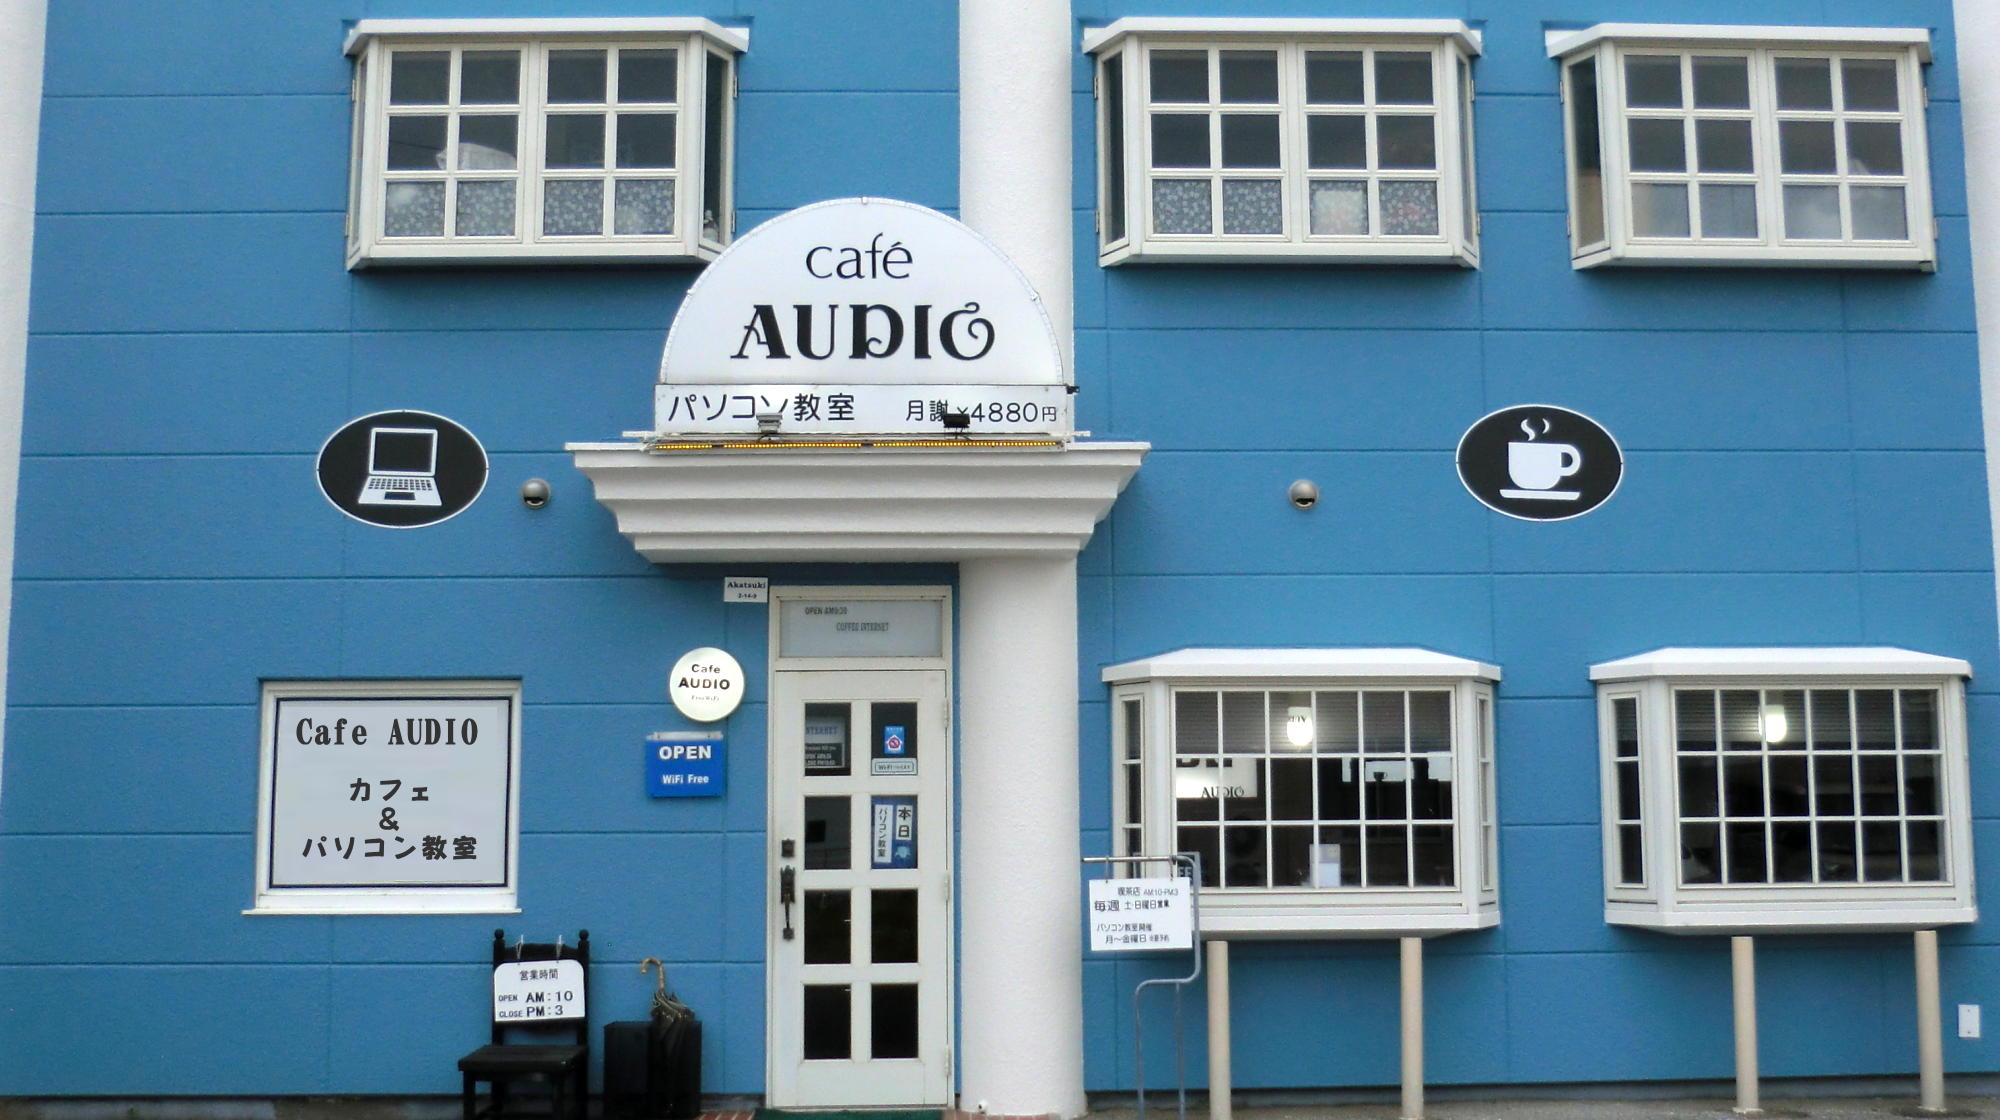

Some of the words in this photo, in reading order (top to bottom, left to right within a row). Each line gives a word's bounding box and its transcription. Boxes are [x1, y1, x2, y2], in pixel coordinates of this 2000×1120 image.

[806, 232, 913, 280] café
[730, 301, 996, 361] AUDIO
[668, 392, 855, 422] パソコン教室
[727, 581, 766, 589] Akatsuki
[804, 606, 823, 615] OPEN
[860, 622, 889, 632] INTERNET
[691, 663, 721, 674] Cafe
[678, 676, 731, 690] AUDIO
[296, 717, 368, 746] Cafe
[388, 717, 479, 746] AUDIO
[659, 745, 712, 760] OPEN
[662, 774, 684, 785] WiFi
[687, 774, 709, 785] Free
[350, 777, 429, 802] カフェ
[379, 806, 400, 832] &
[898, 807, 912, 838] 本日
[302, 835, 478, 861] パソコン教室
[1094, 899, 1120, 912] 毎週
[519, 968, 559, 982] 営業時間
[498, 994, 518, 1002] OPEN
[499, 1010, 523, 1018] CLOSE
